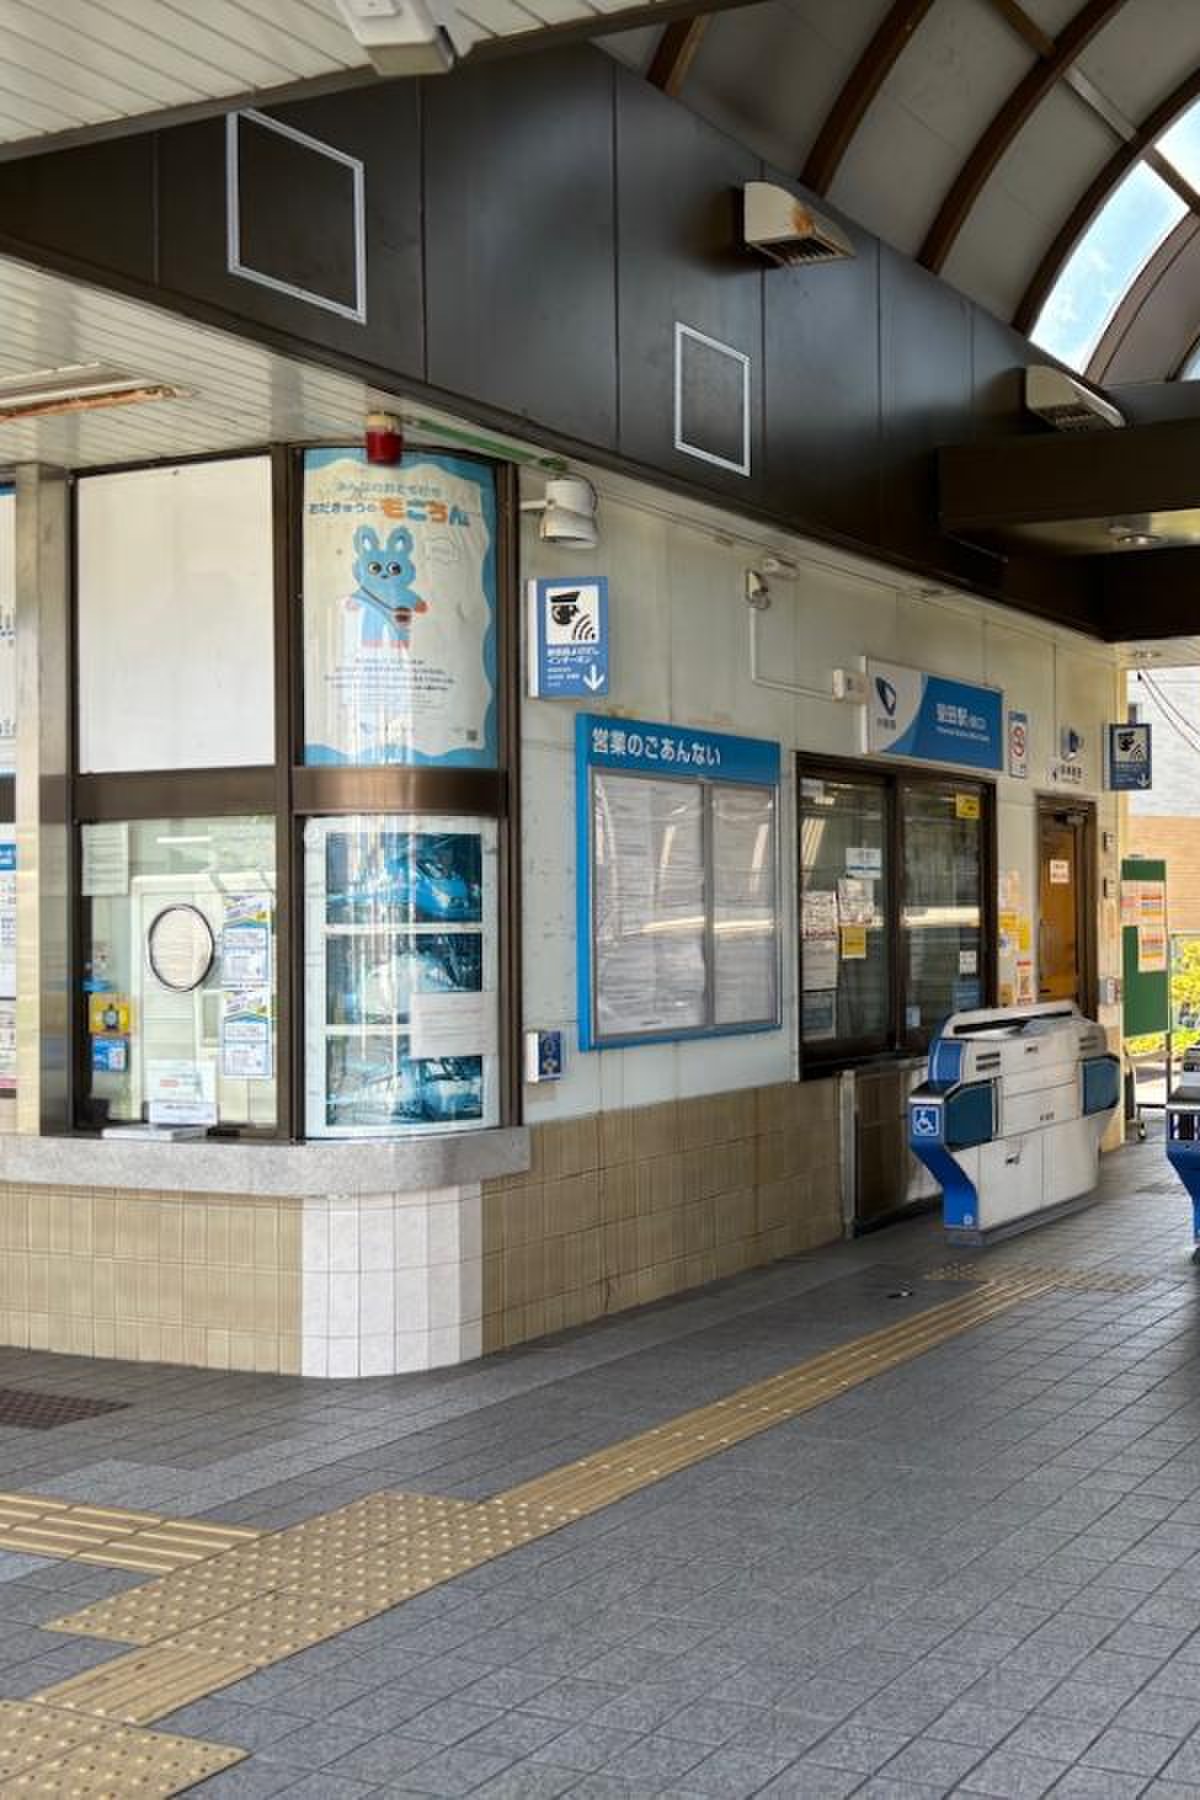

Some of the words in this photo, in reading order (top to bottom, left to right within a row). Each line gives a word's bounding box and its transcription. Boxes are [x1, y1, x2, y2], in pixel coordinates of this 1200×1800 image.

[592, 727, 721, 766] 営業のごあんない
